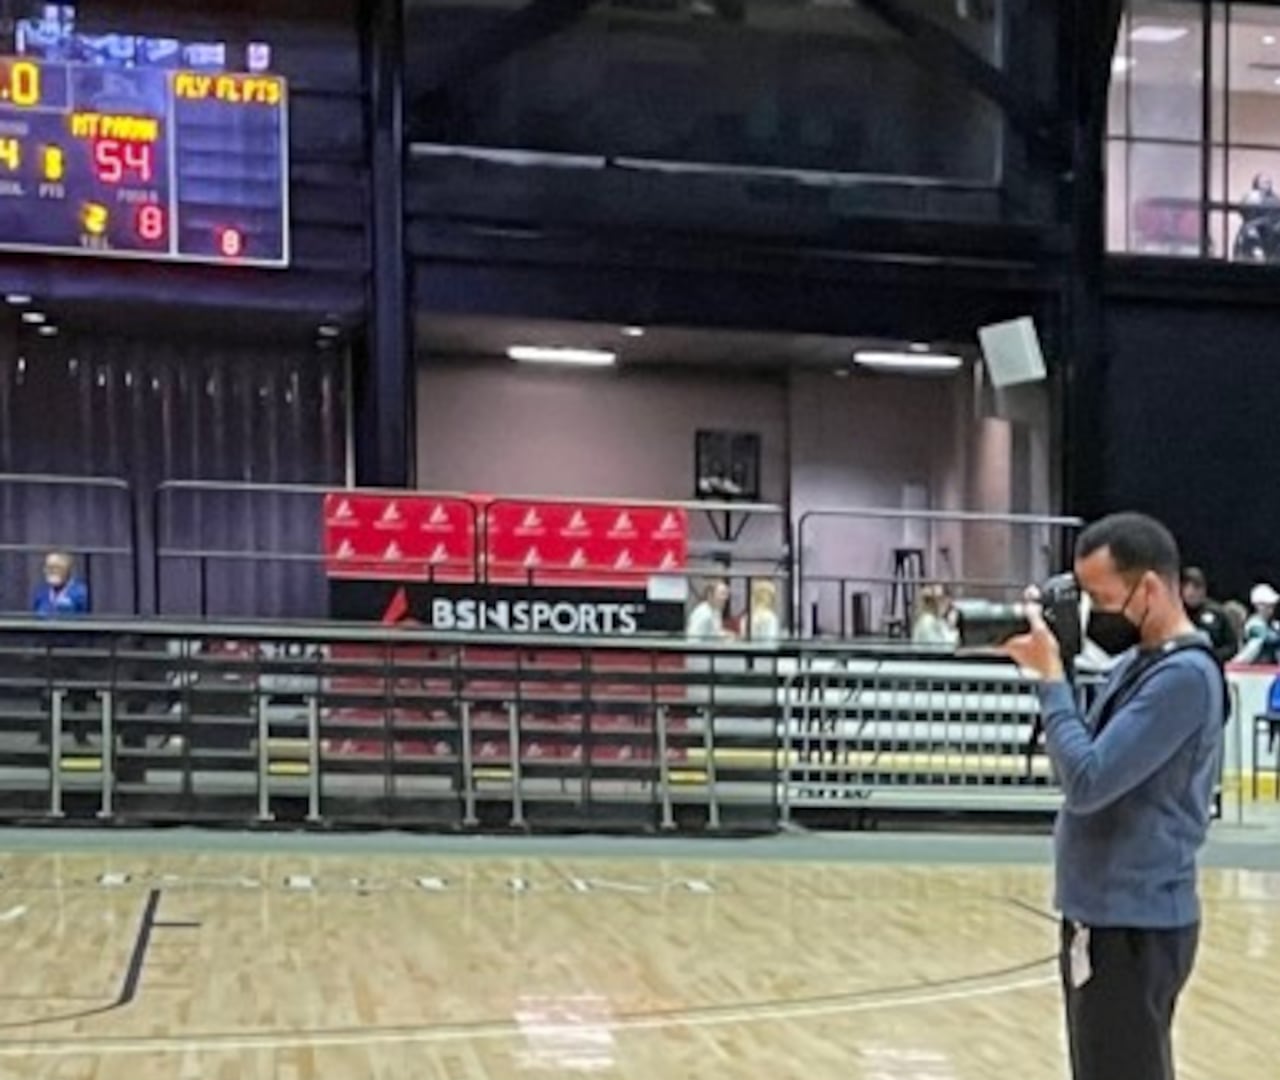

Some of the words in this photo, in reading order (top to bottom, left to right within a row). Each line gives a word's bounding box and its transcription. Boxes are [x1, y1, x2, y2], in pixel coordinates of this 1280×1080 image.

[96, 140, 151, 181] 54
[139, 206, 163, 239] 8
[431, 598, 509, 631] BSN
[512, 603, 637, 635] SPORTS
